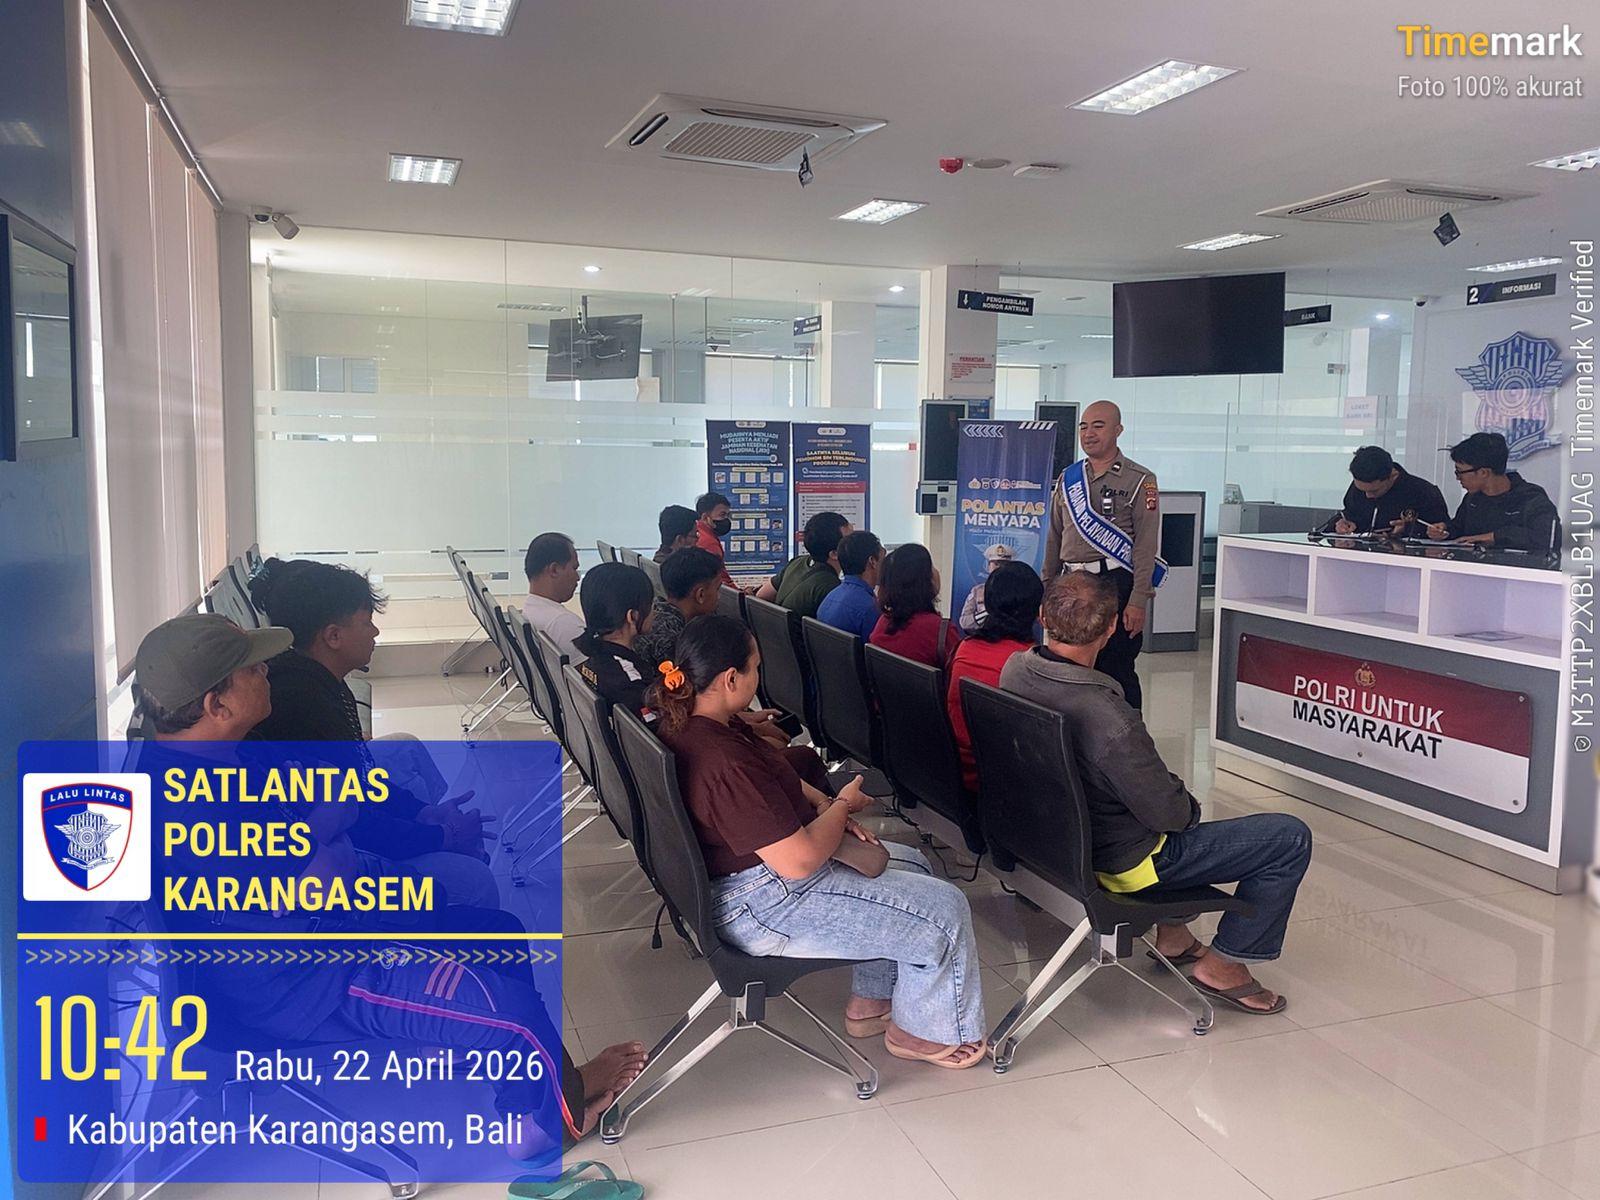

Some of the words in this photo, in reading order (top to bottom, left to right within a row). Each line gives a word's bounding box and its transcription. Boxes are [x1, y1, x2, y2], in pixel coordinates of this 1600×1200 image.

[985, 296, 1027, 307] PENGAMBILAN
[1469, 287, 1479, 303] 2
[1501, 282, 1542, 294] INFORMASI
[982, 302, 1004, 311] NOMOR
[1004, 305, 1030, 313] ANTRIAN
[961, 498, 1046, 516] POLANTAS
[964, 513, 1041, 529] MENYAPA
[1077, 511, 1123, 553] PELAYANAN
[1293, 675, 1356, 708] POLRI
[1361, 694, 1444, 733] UNTUK
[1293, 699, 1443, 759] MASYARAKAT
